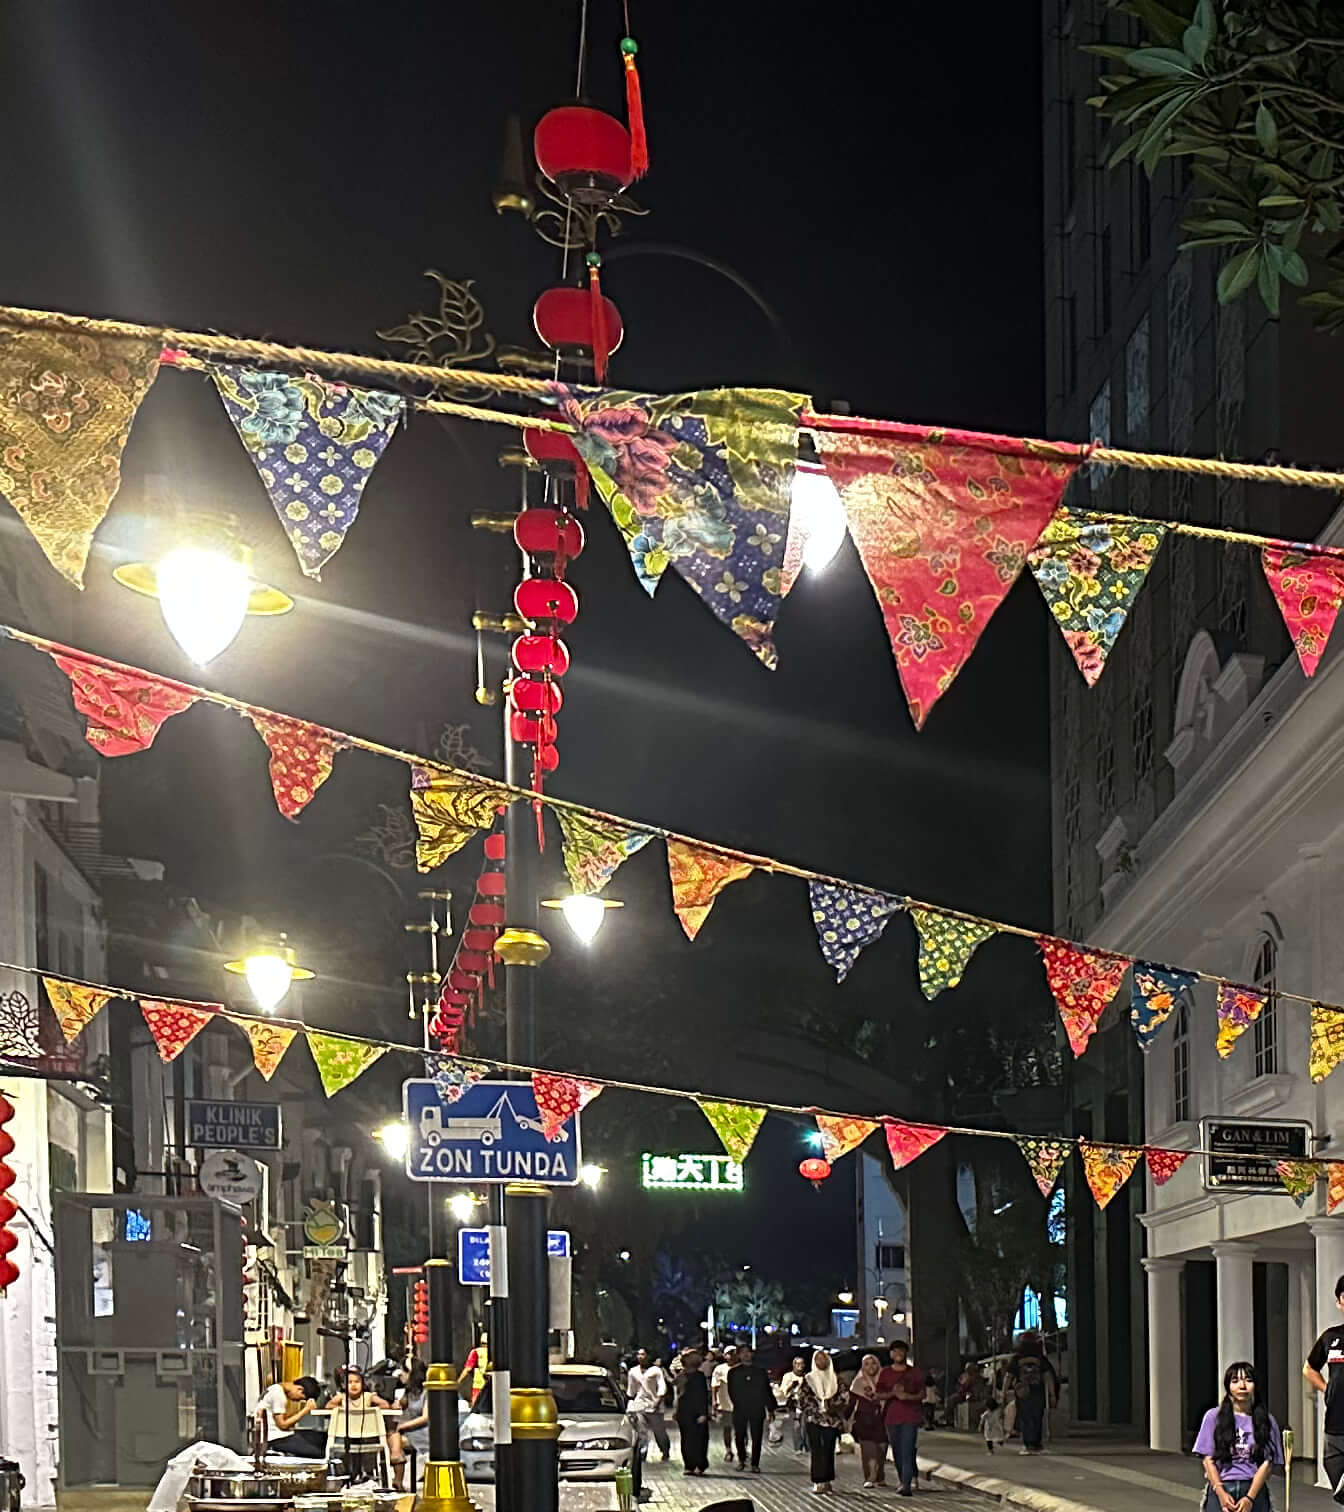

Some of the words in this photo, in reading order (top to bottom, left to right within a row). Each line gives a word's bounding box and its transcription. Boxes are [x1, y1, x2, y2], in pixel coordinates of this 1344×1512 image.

[206, 1106, 262, 1125] KLINIK
[193, 1124, 275, 1144] PEOPLE'S
[1222, 1128, 1250, 1142] GAN
[1265, 1131, 1289, 1143] LIM
[420, 1149, 472, 1173] ZON
[480, 1151, 568, 1177] TUNDA
